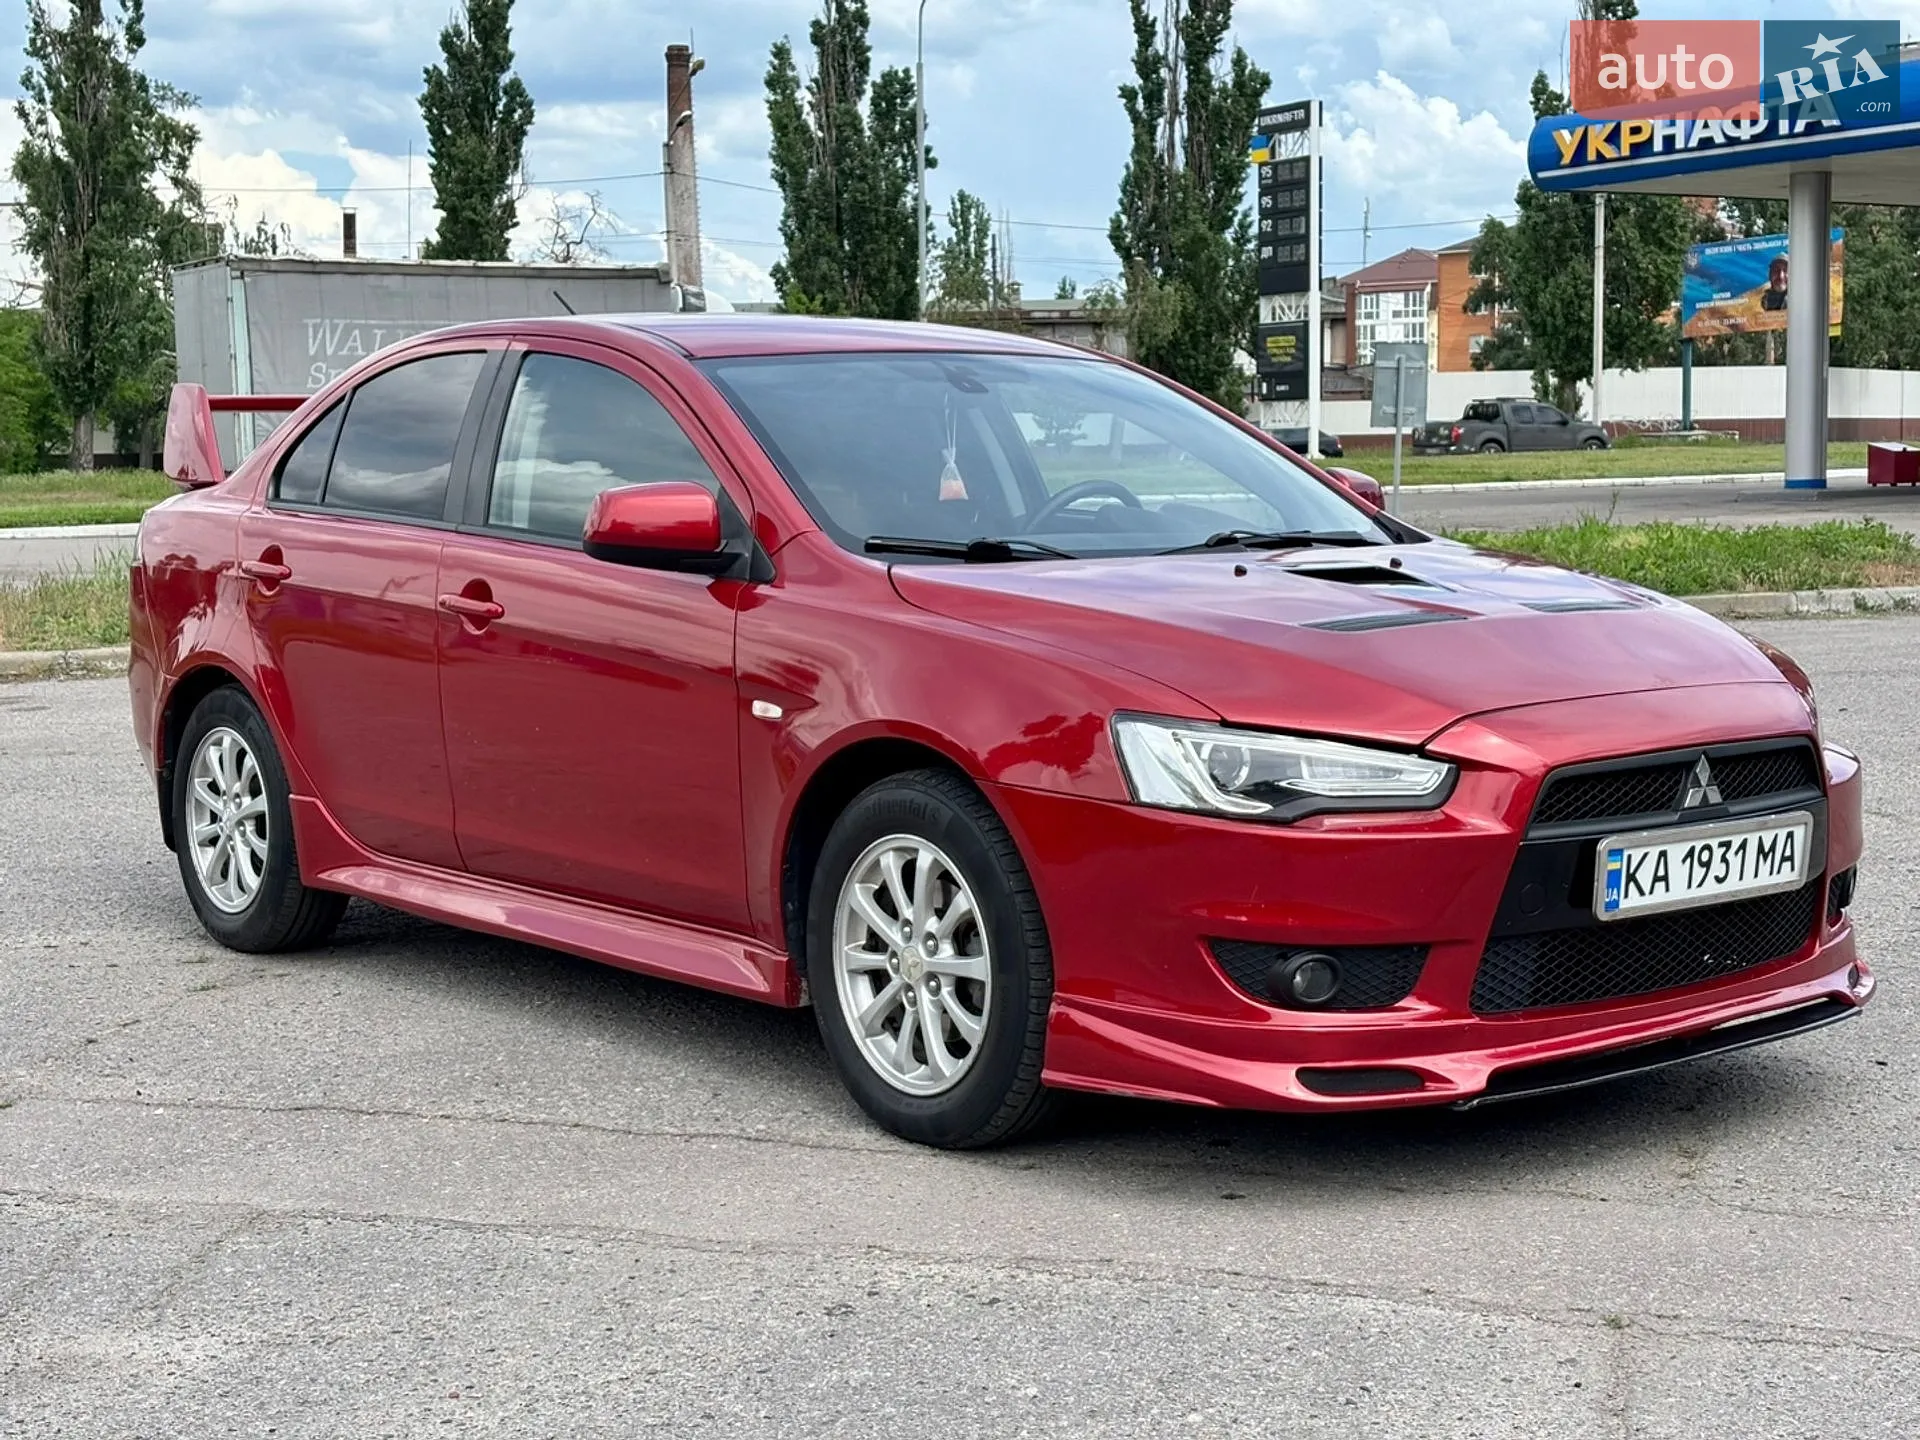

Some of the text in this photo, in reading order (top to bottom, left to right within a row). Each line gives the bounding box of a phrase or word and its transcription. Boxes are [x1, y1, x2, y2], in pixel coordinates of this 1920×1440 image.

[1261, 165, 1273, 178] 95
[1261, 195, 1273, 208] 95
[1261, 219, 1273, 232] 92
[1623, 830, 1796, 899] KA 1931 MA
